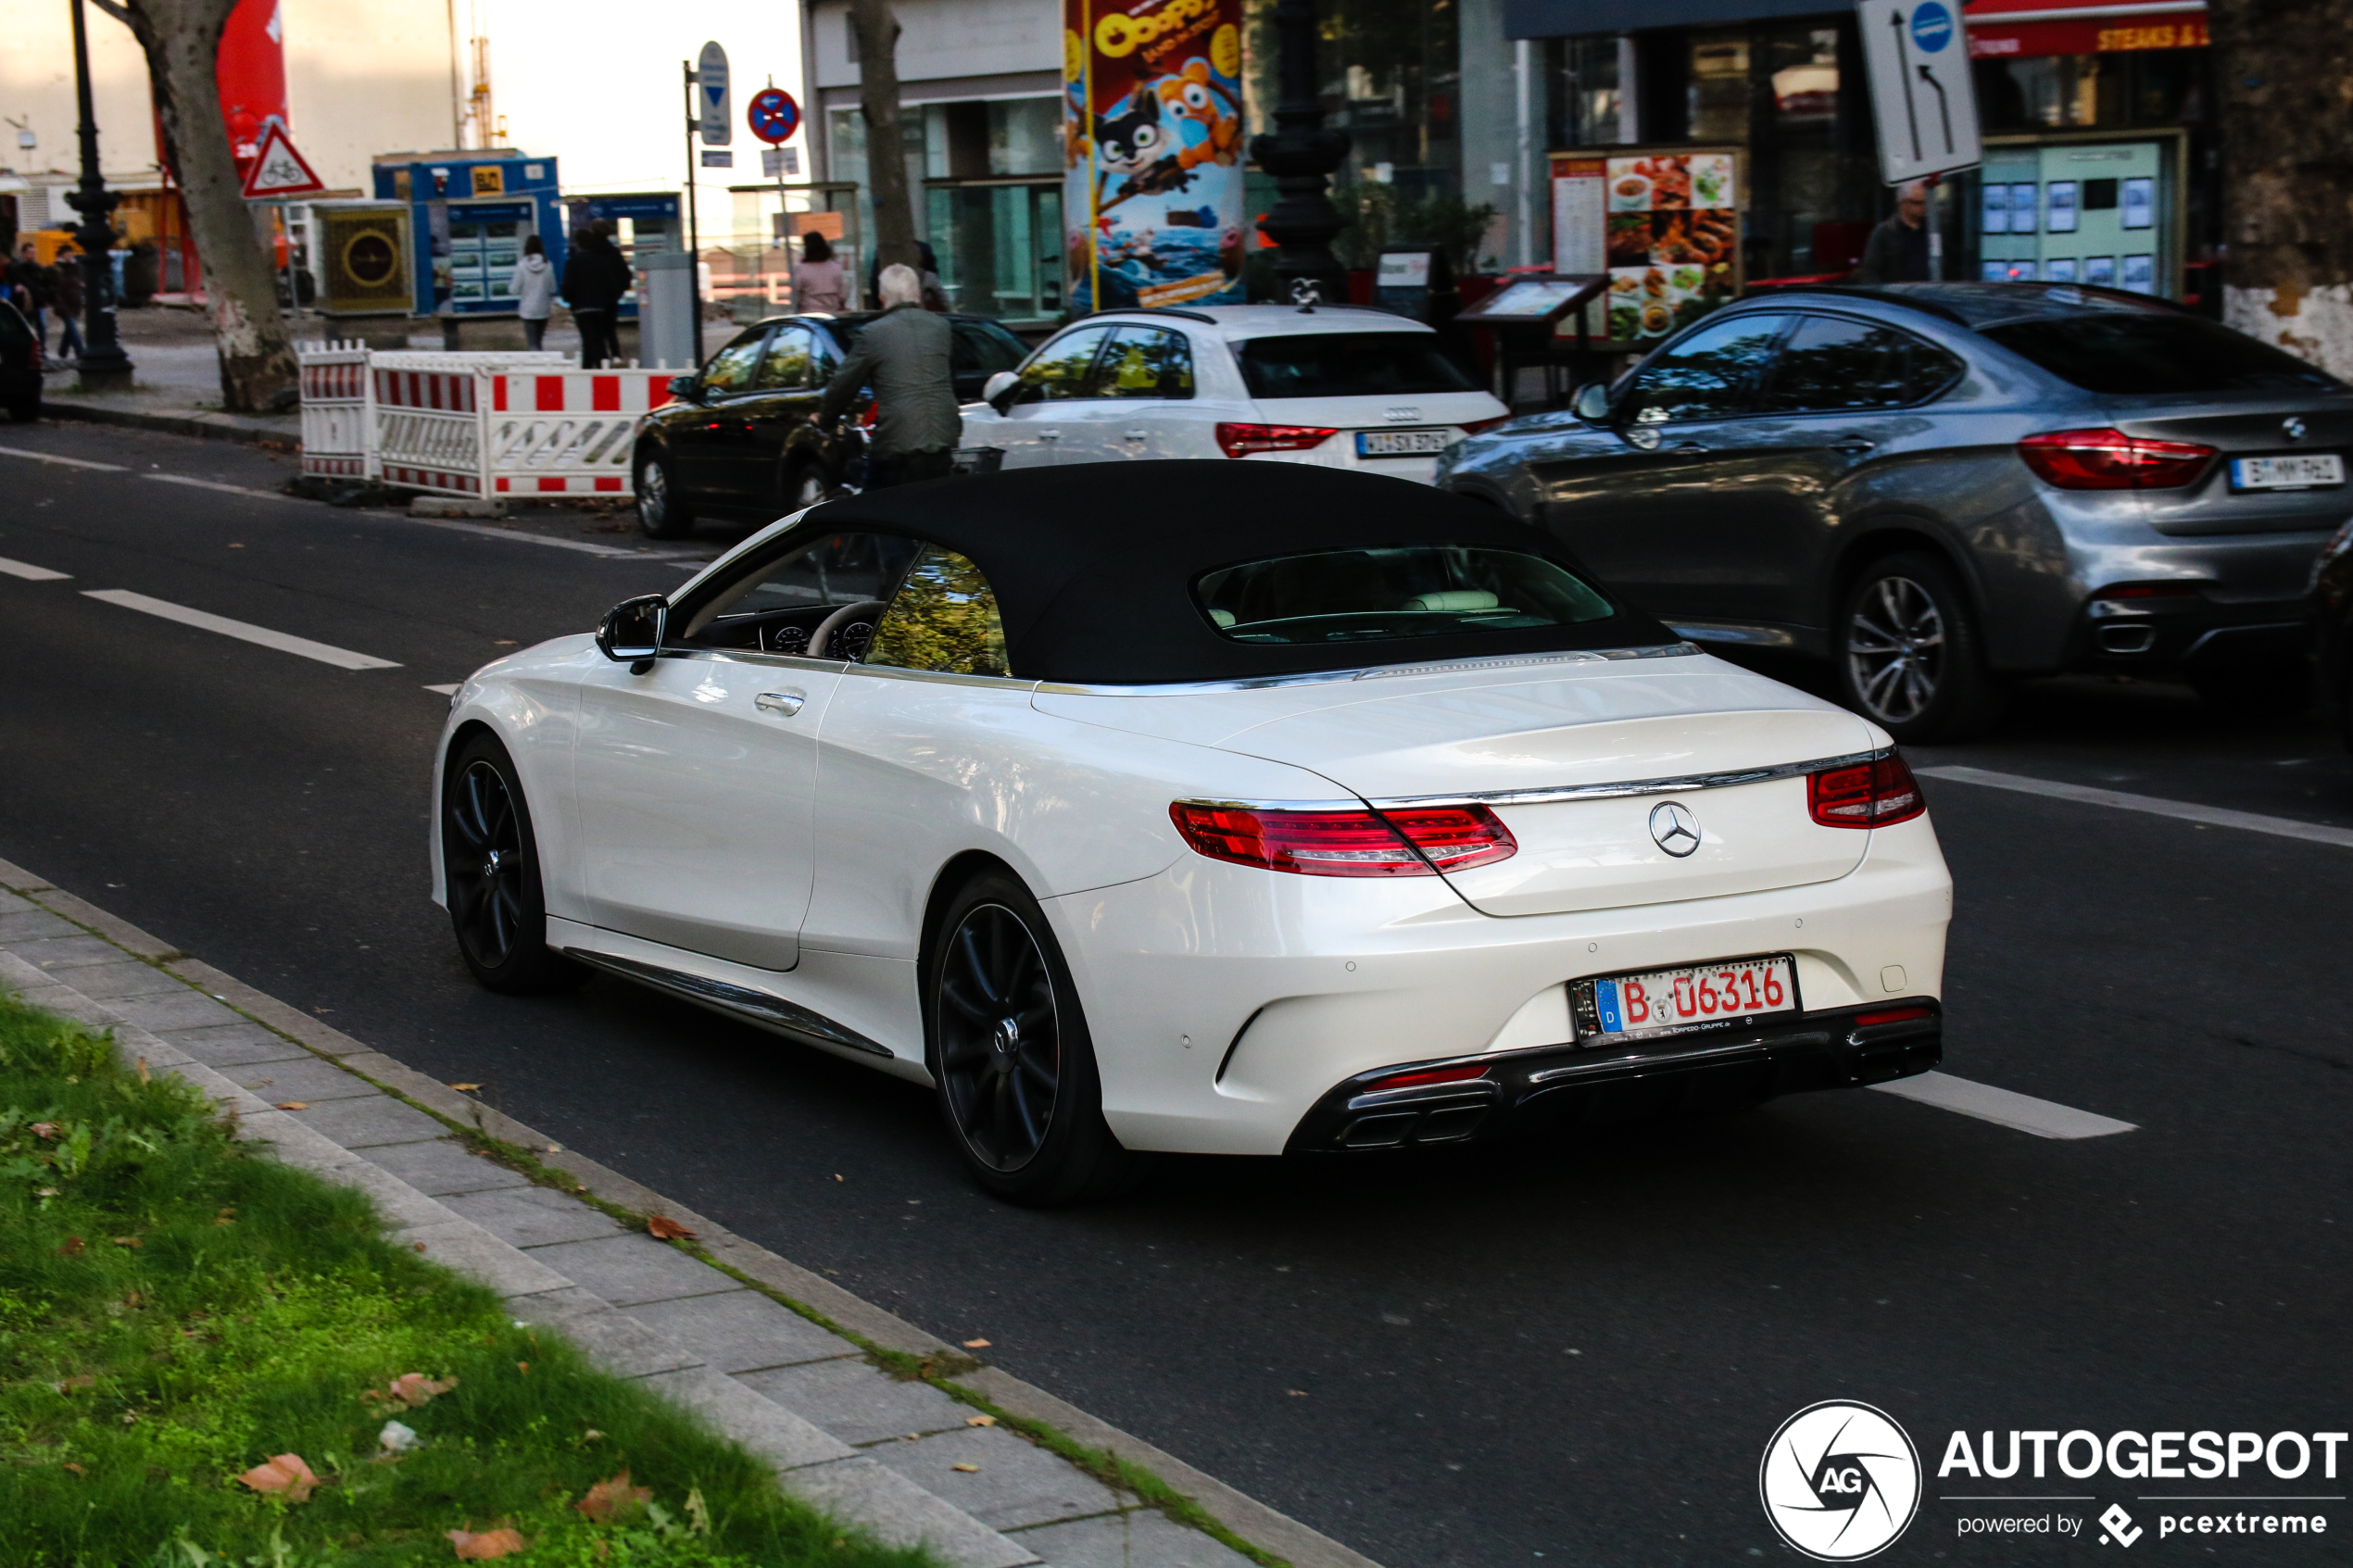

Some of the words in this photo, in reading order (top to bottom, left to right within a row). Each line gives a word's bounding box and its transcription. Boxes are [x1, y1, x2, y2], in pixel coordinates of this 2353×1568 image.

[1624, 983, 1650, 1024] B
[1672, 967, 1784, 1018] 06316
[1605, 1011, 1615, 1023] D
